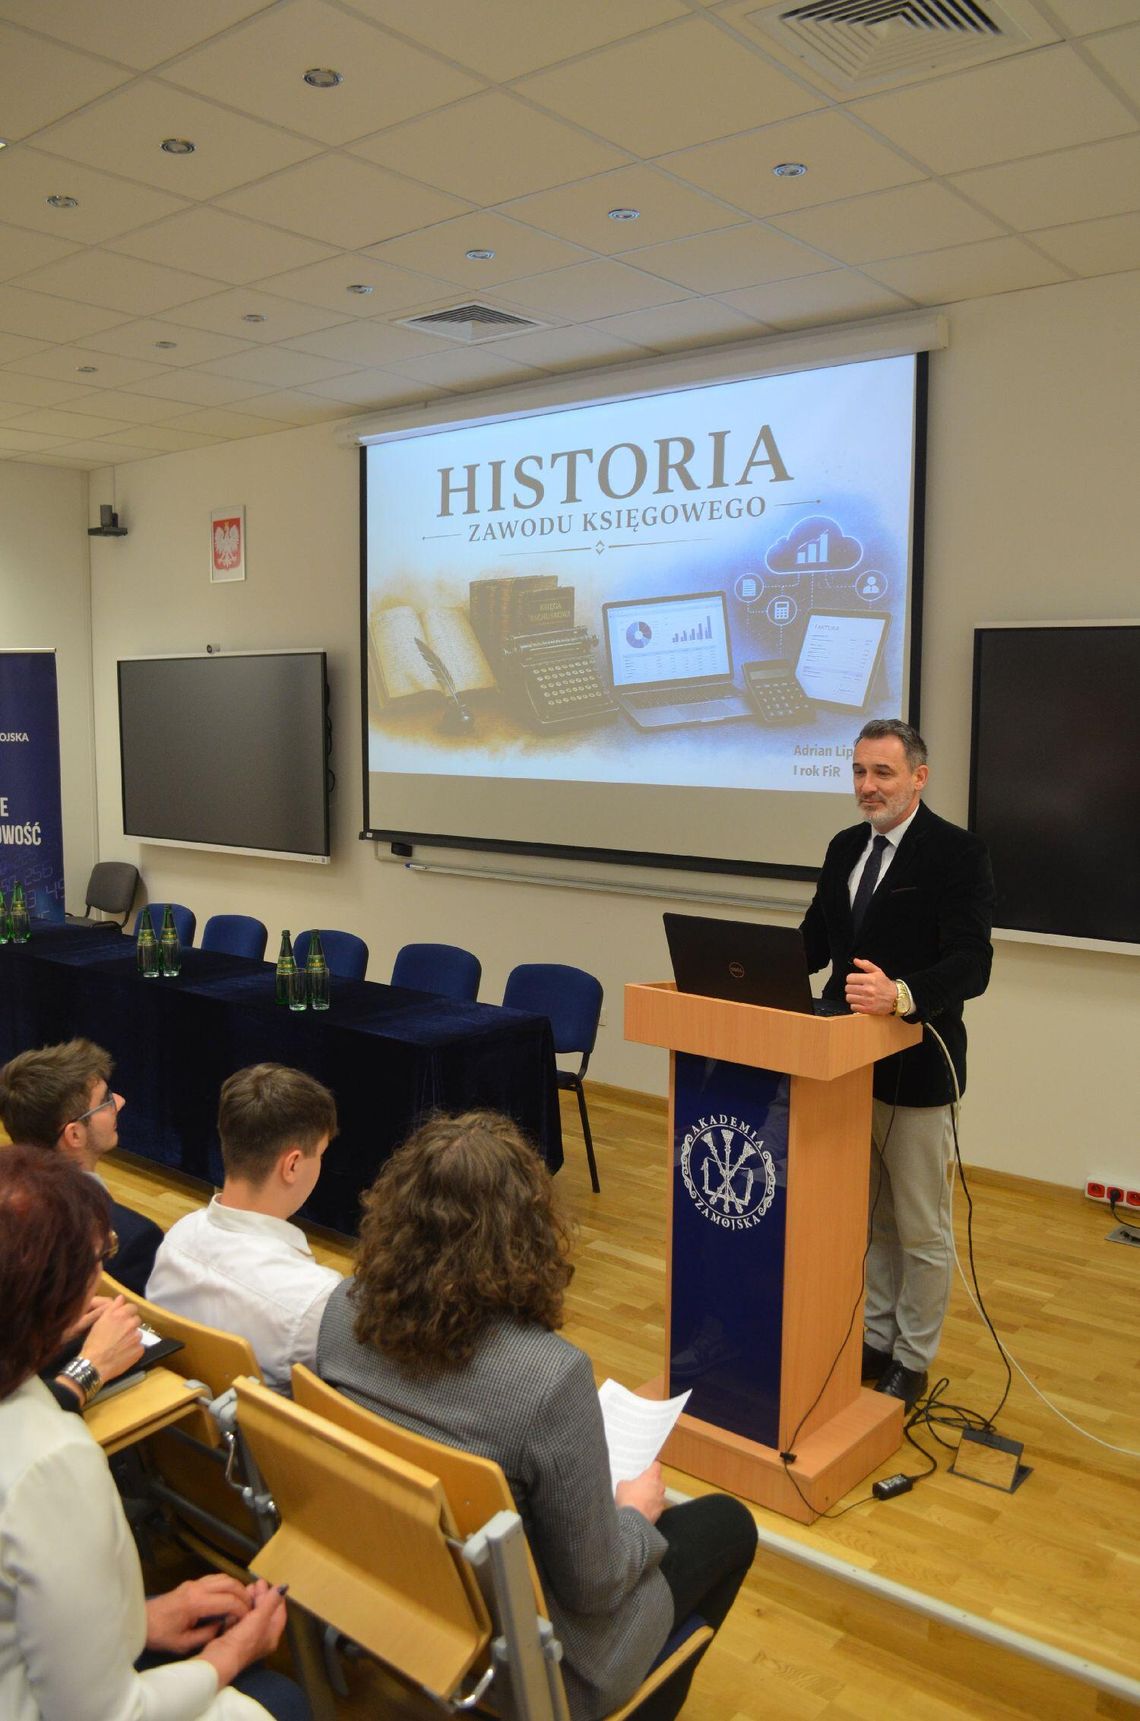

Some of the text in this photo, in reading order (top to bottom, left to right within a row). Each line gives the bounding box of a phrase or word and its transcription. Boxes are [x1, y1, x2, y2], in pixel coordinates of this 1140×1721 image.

[436, 424, 794, 518] HISTORIA
[468, 496, 766, 542] ZAWODU KSIĘGOWEGO
[0, 732, 30, 742] OJSKA
[793, 743, 833, 757] Adrian
[793, 764, 841, 777] I rok FiR
[0, 821, 42, 846] WOŚĆ
[690, 1114, 765, 1150] AKADEMIA
[694, 1199, 761, 1231] ZAMOJSKA
